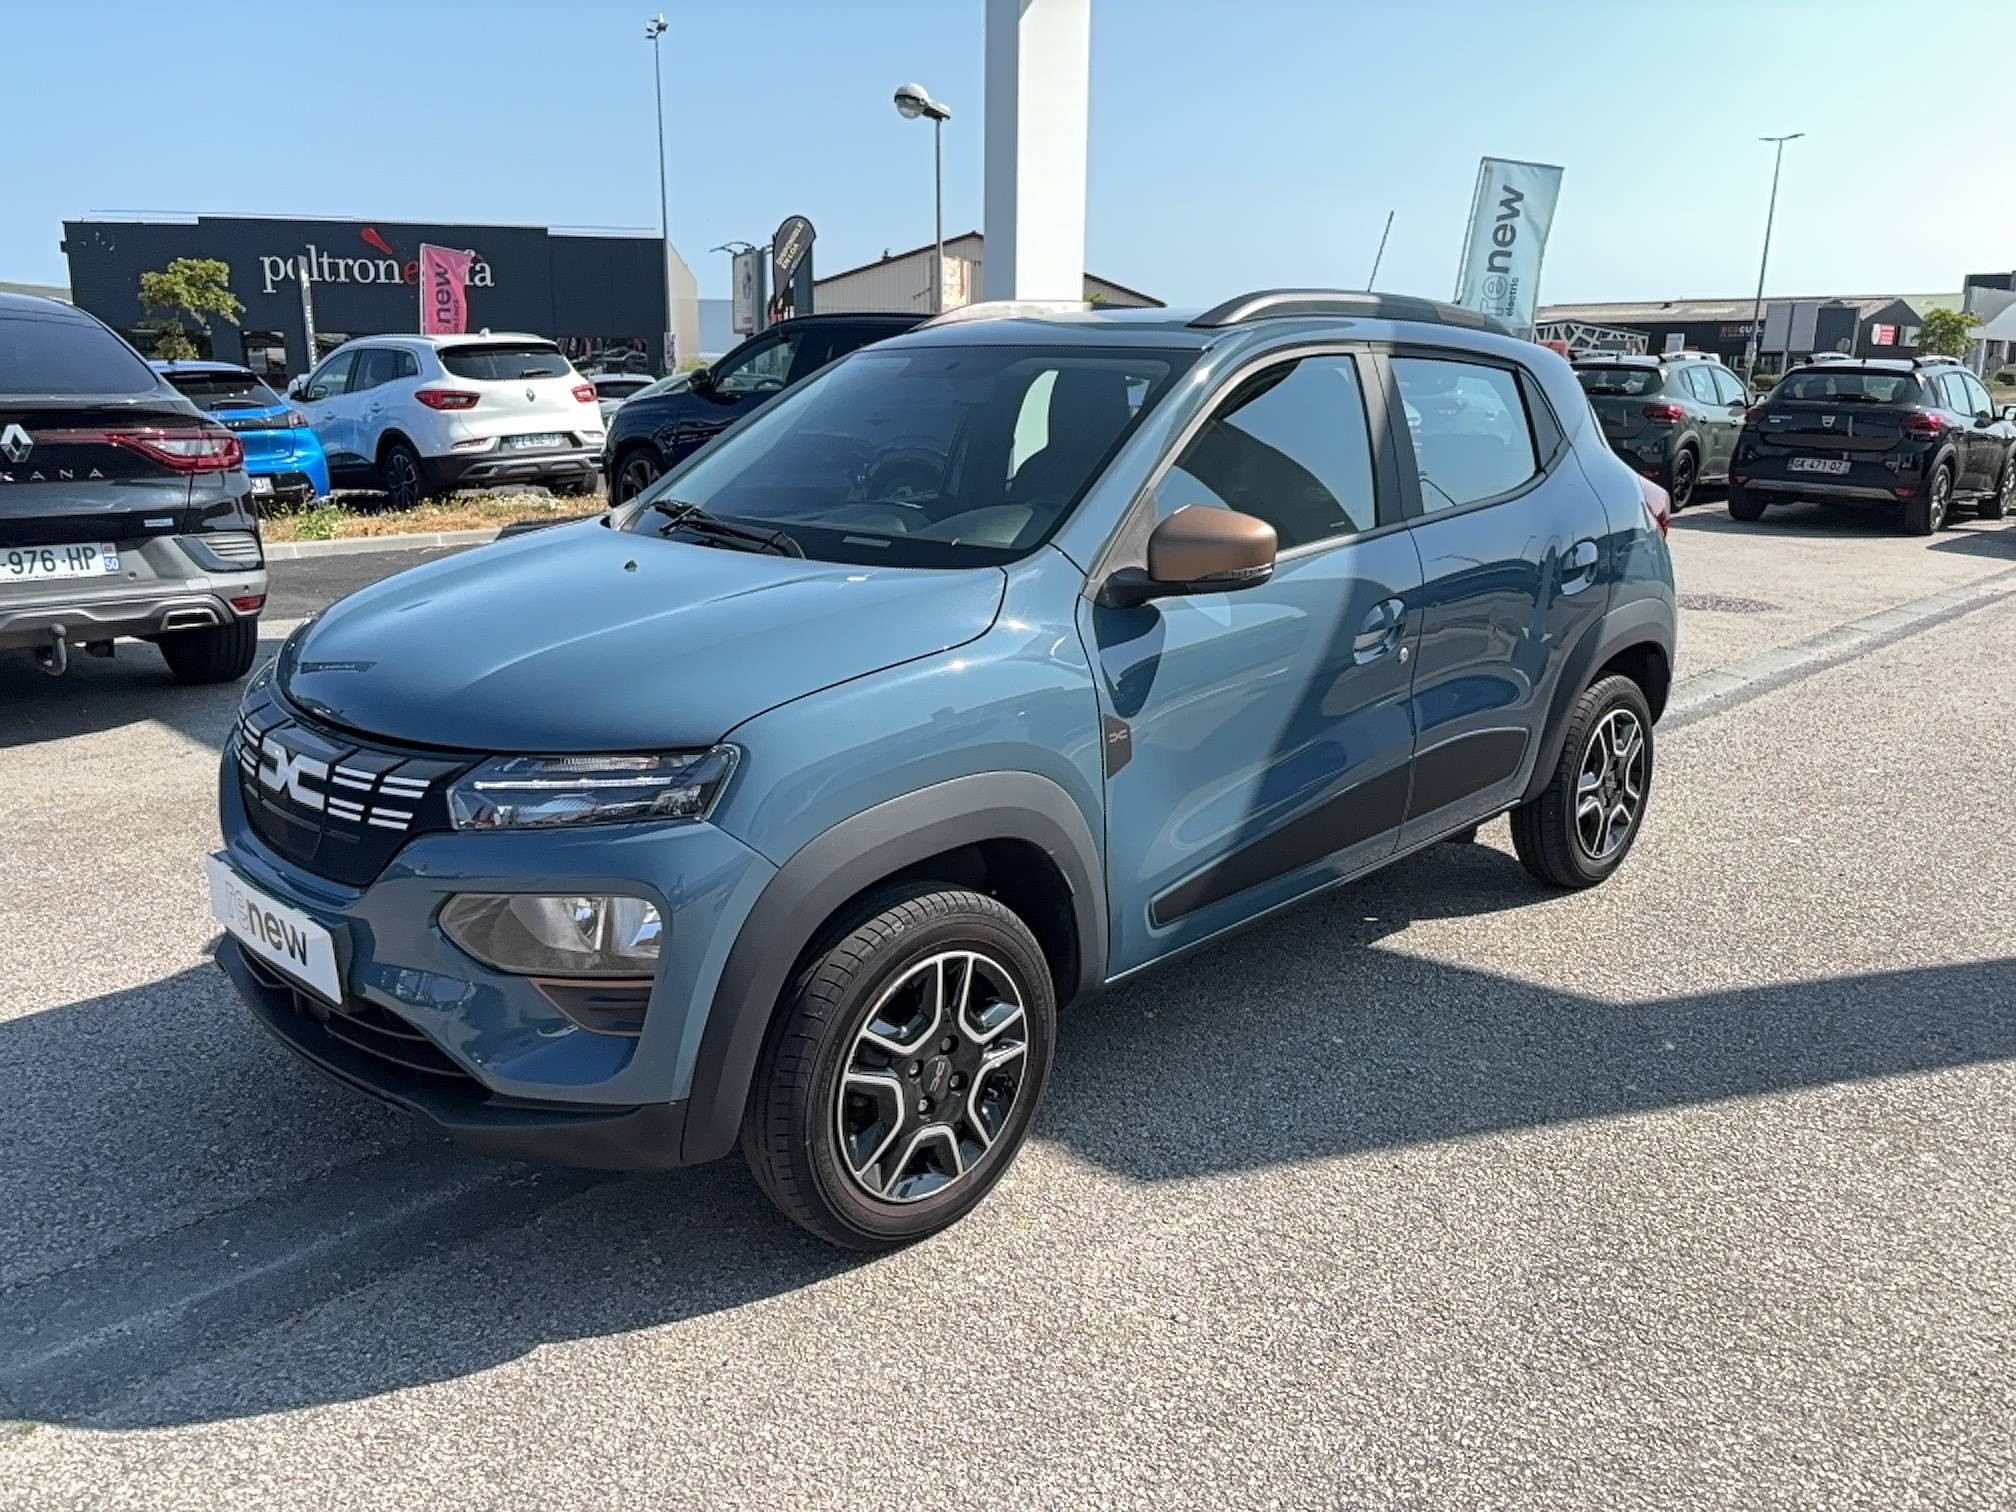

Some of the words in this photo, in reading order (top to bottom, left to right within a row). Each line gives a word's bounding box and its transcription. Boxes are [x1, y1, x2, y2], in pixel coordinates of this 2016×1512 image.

[1480, 185, 1524, 317] renew
[1506, 276, 1520, 317] electric
[104, 557, 120, 571] 50
[225, 880, 308, 967] renew
